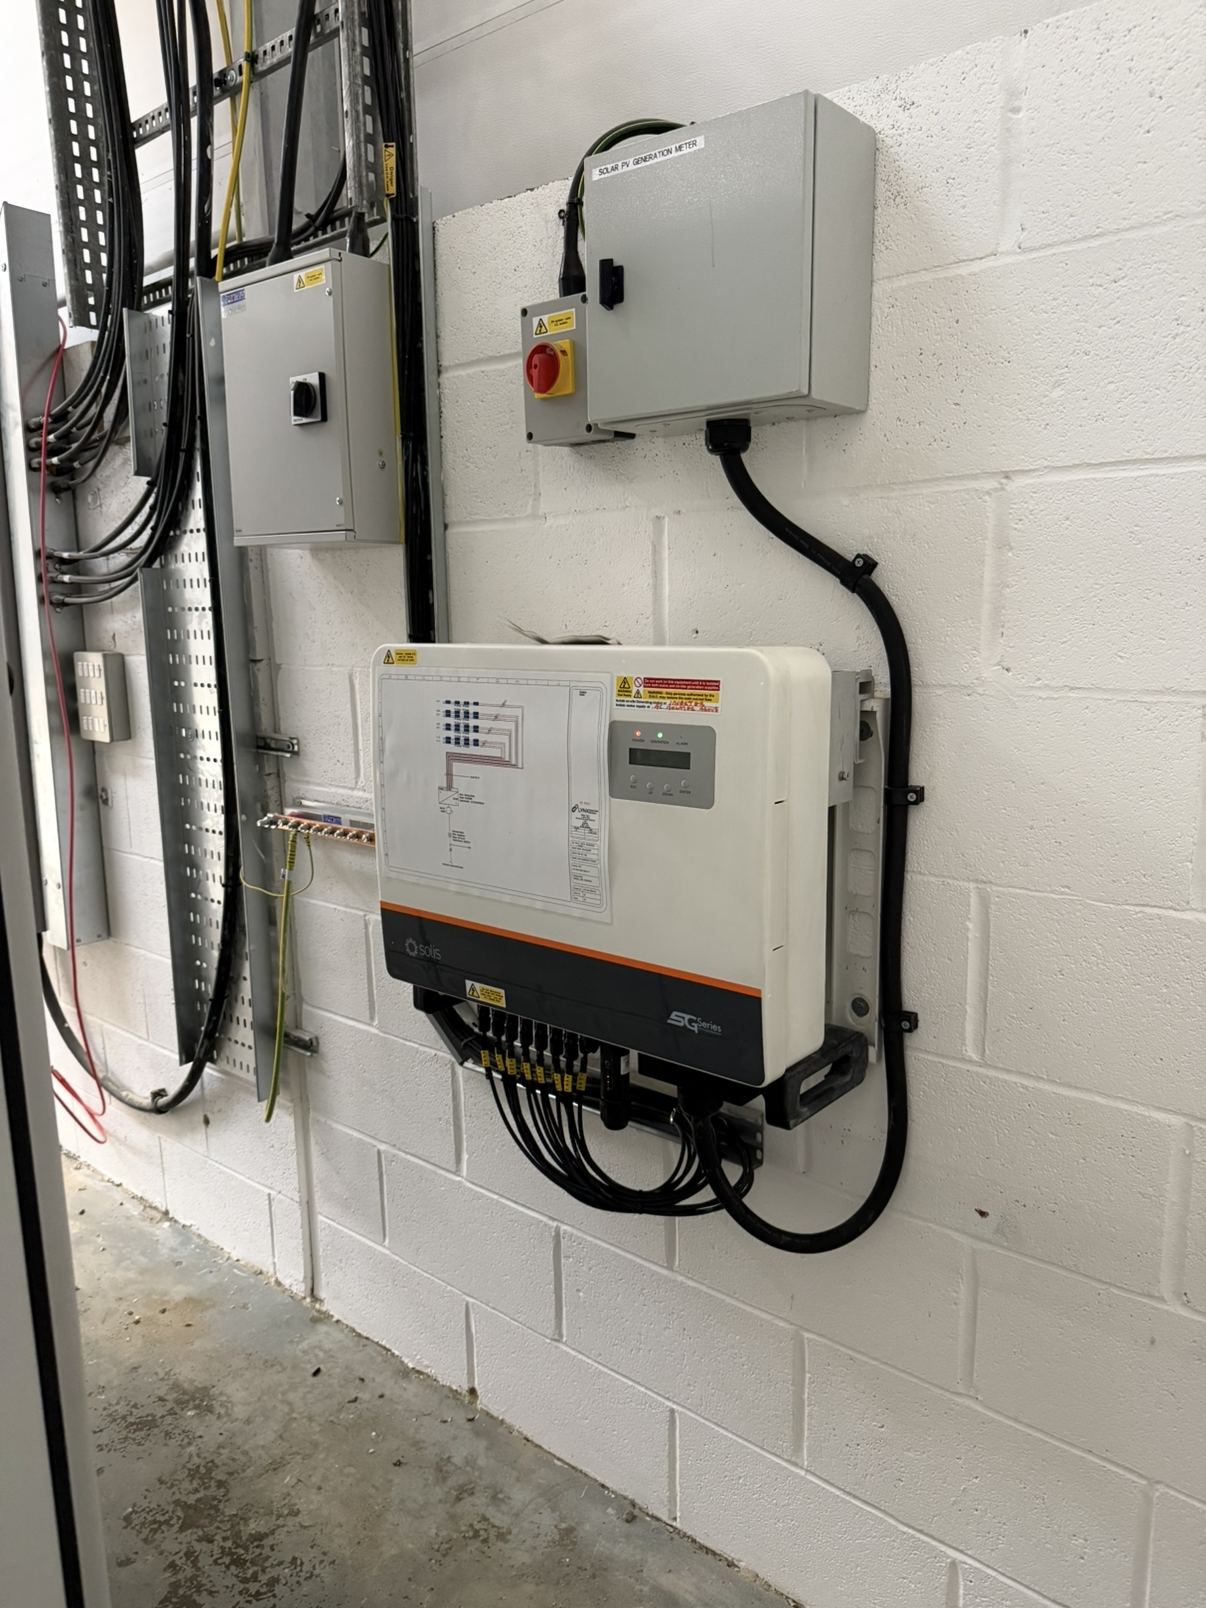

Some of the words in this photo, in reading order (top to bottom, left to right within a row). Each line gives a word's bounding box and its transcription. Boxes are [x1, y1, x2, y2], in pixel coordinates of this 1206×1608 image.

[598, 163, 619, 177] SOLAR
[621, 160, 631, 170] PV
[632, 147, 673, 165] GENERATION
[674, 139, 698, 153] METER
[418, 943, 442, 960] solis
